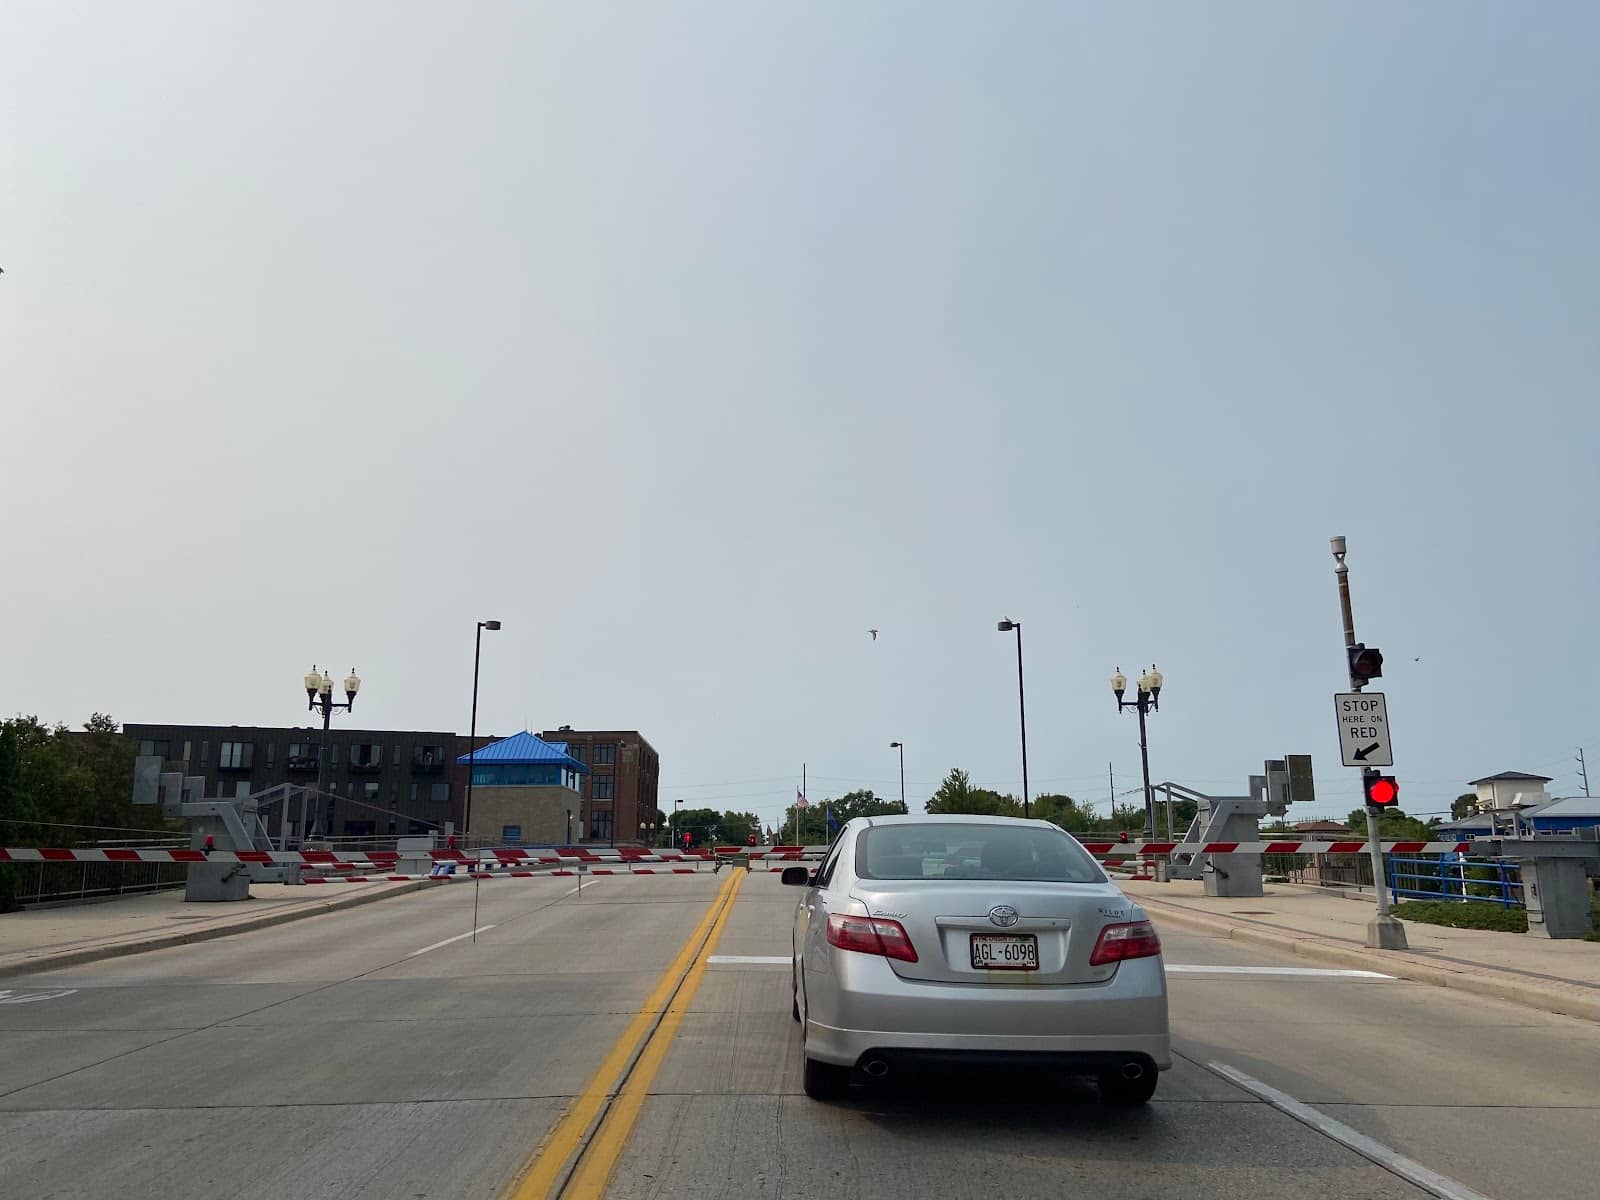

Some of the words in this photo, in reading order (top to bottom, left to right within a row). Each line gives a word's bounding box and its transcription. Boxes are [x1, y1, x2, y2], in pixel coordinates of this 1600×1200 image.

[1343, 701, 1378, 711] STOP
[1351, 727, 1377, 738] RED
[974, 943, 1035, 961] AGL-6098
